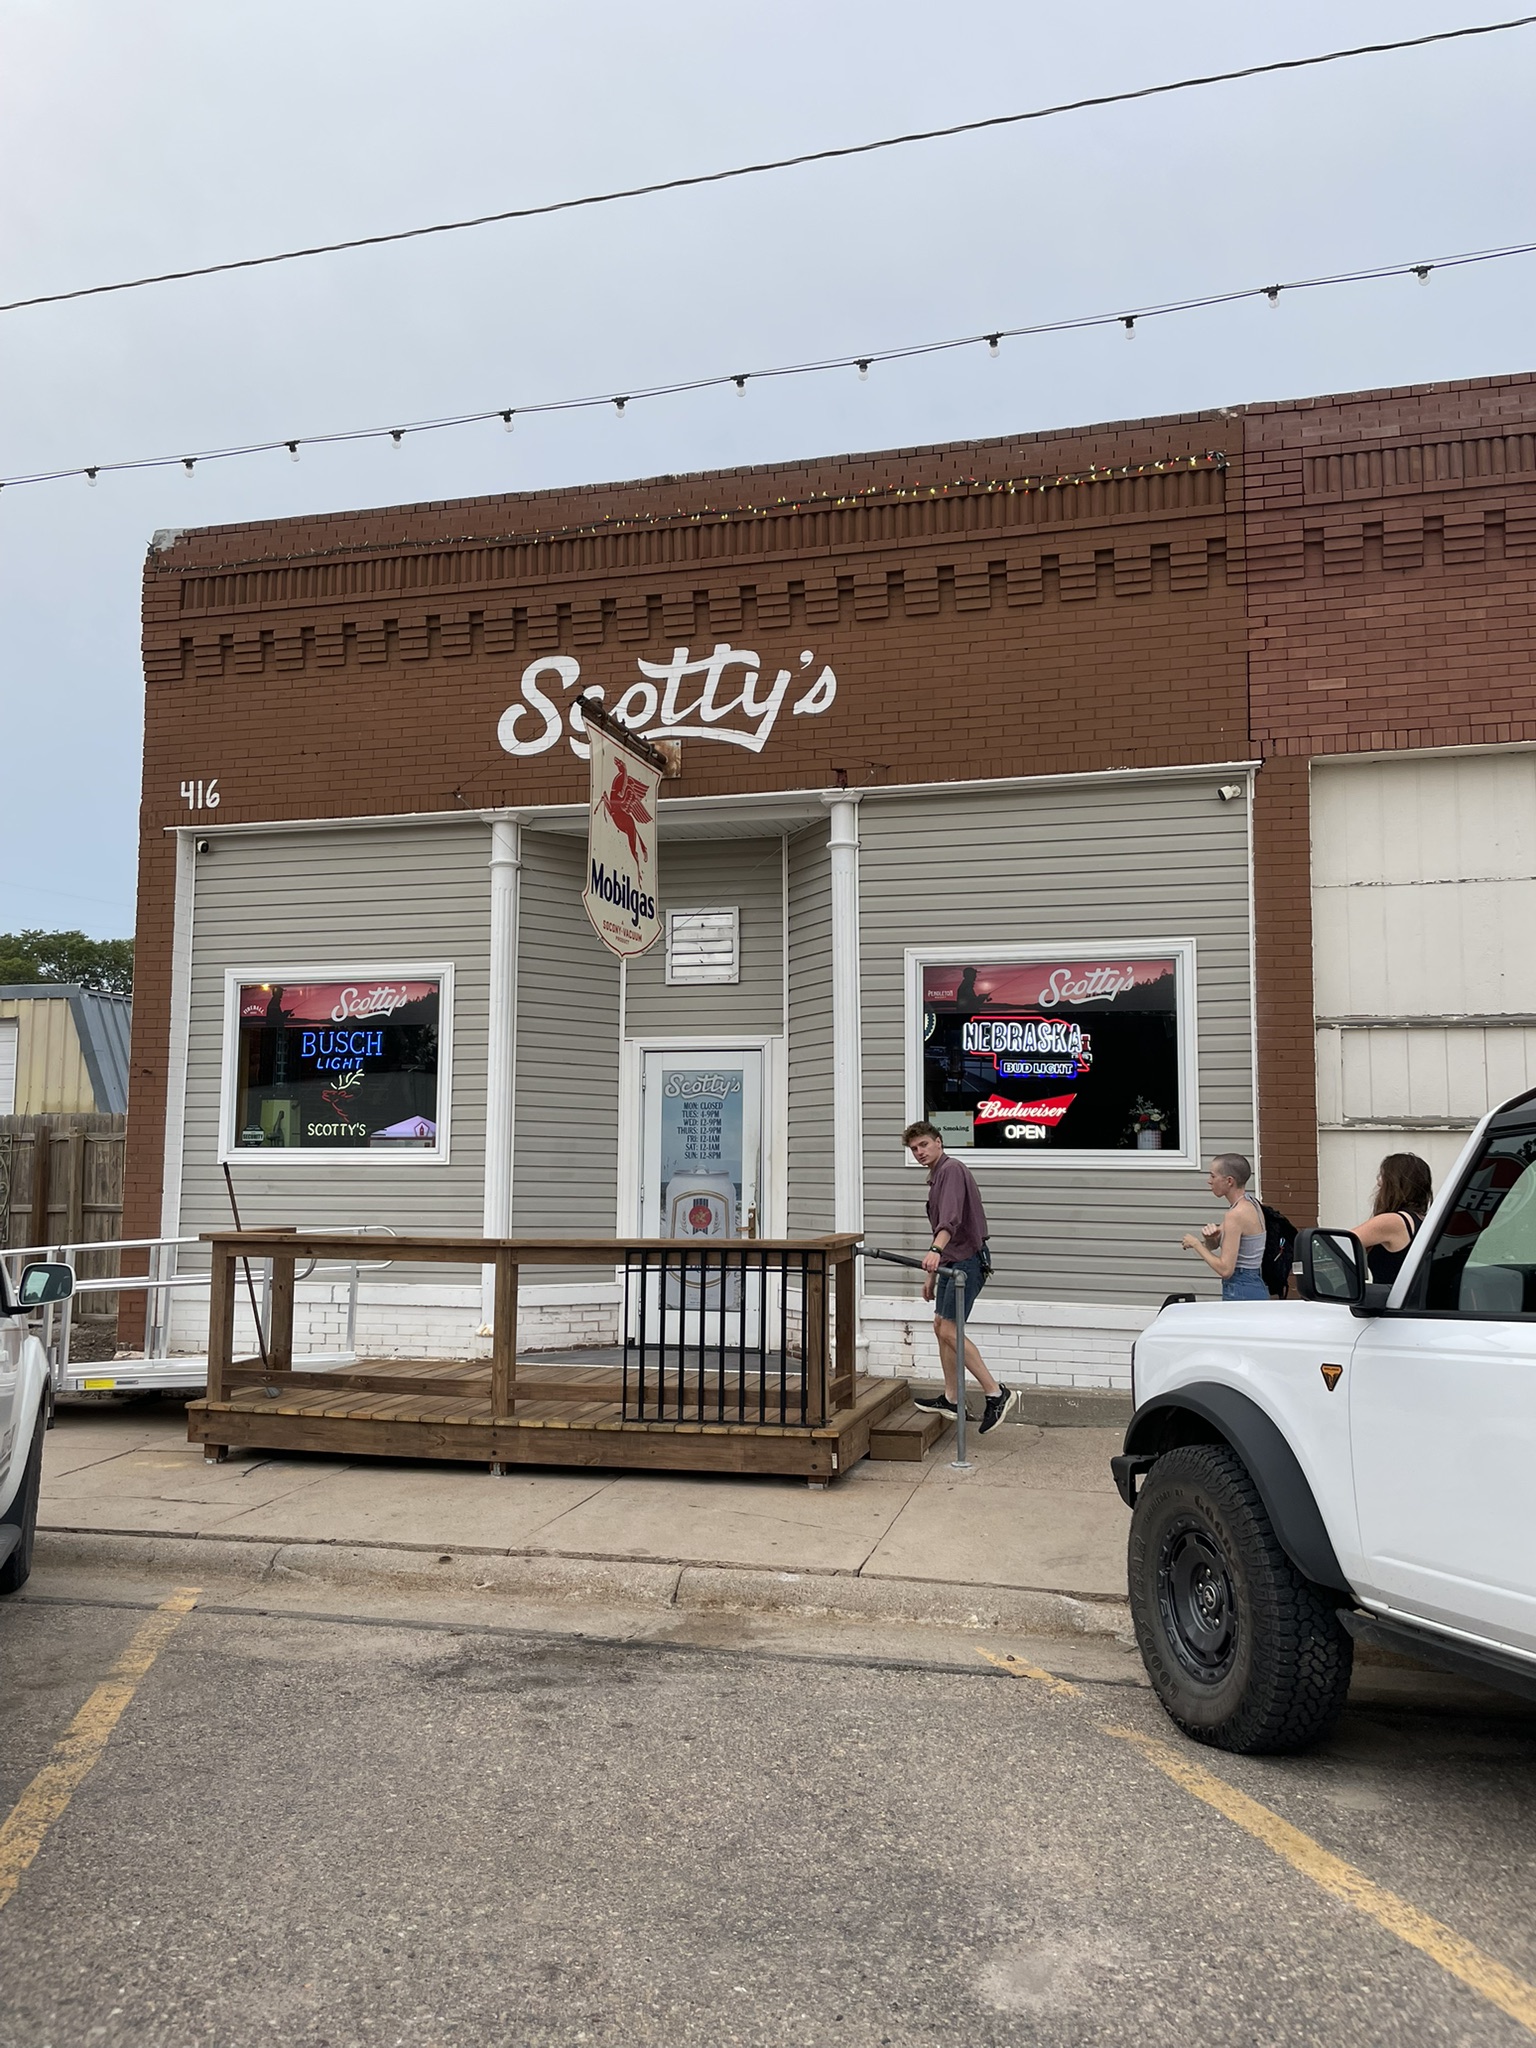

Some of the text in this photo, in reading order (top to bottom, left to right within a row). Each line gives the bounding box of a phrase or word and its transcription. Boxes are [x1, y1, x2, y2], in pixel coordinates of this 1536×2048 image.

[497, 643, 837, 759] Scotty's
[181, 779, 220, 809] 416
[591, 858, 655, 927] Mobilgas
[1038, 966, 1135, 1008] Scotty's
[331, 986, 408, 1022] Scotty's
[301, 1031, 383, 1058] BUSCH
[963, 1022, 1082, 1053] NEBRASKA
[316, 1057, 364, 1070] LIGHT
[1003, 1062, 1074, 1075] BUD LIGHT
[664, 1073, 741, 1100] Scotty's
[977, 1101, 1067, 1119] Budweiser
[307, 1122, 367, 1137] SCOTTY'S
[1004, 1125, 1046, 1140] OPEN
